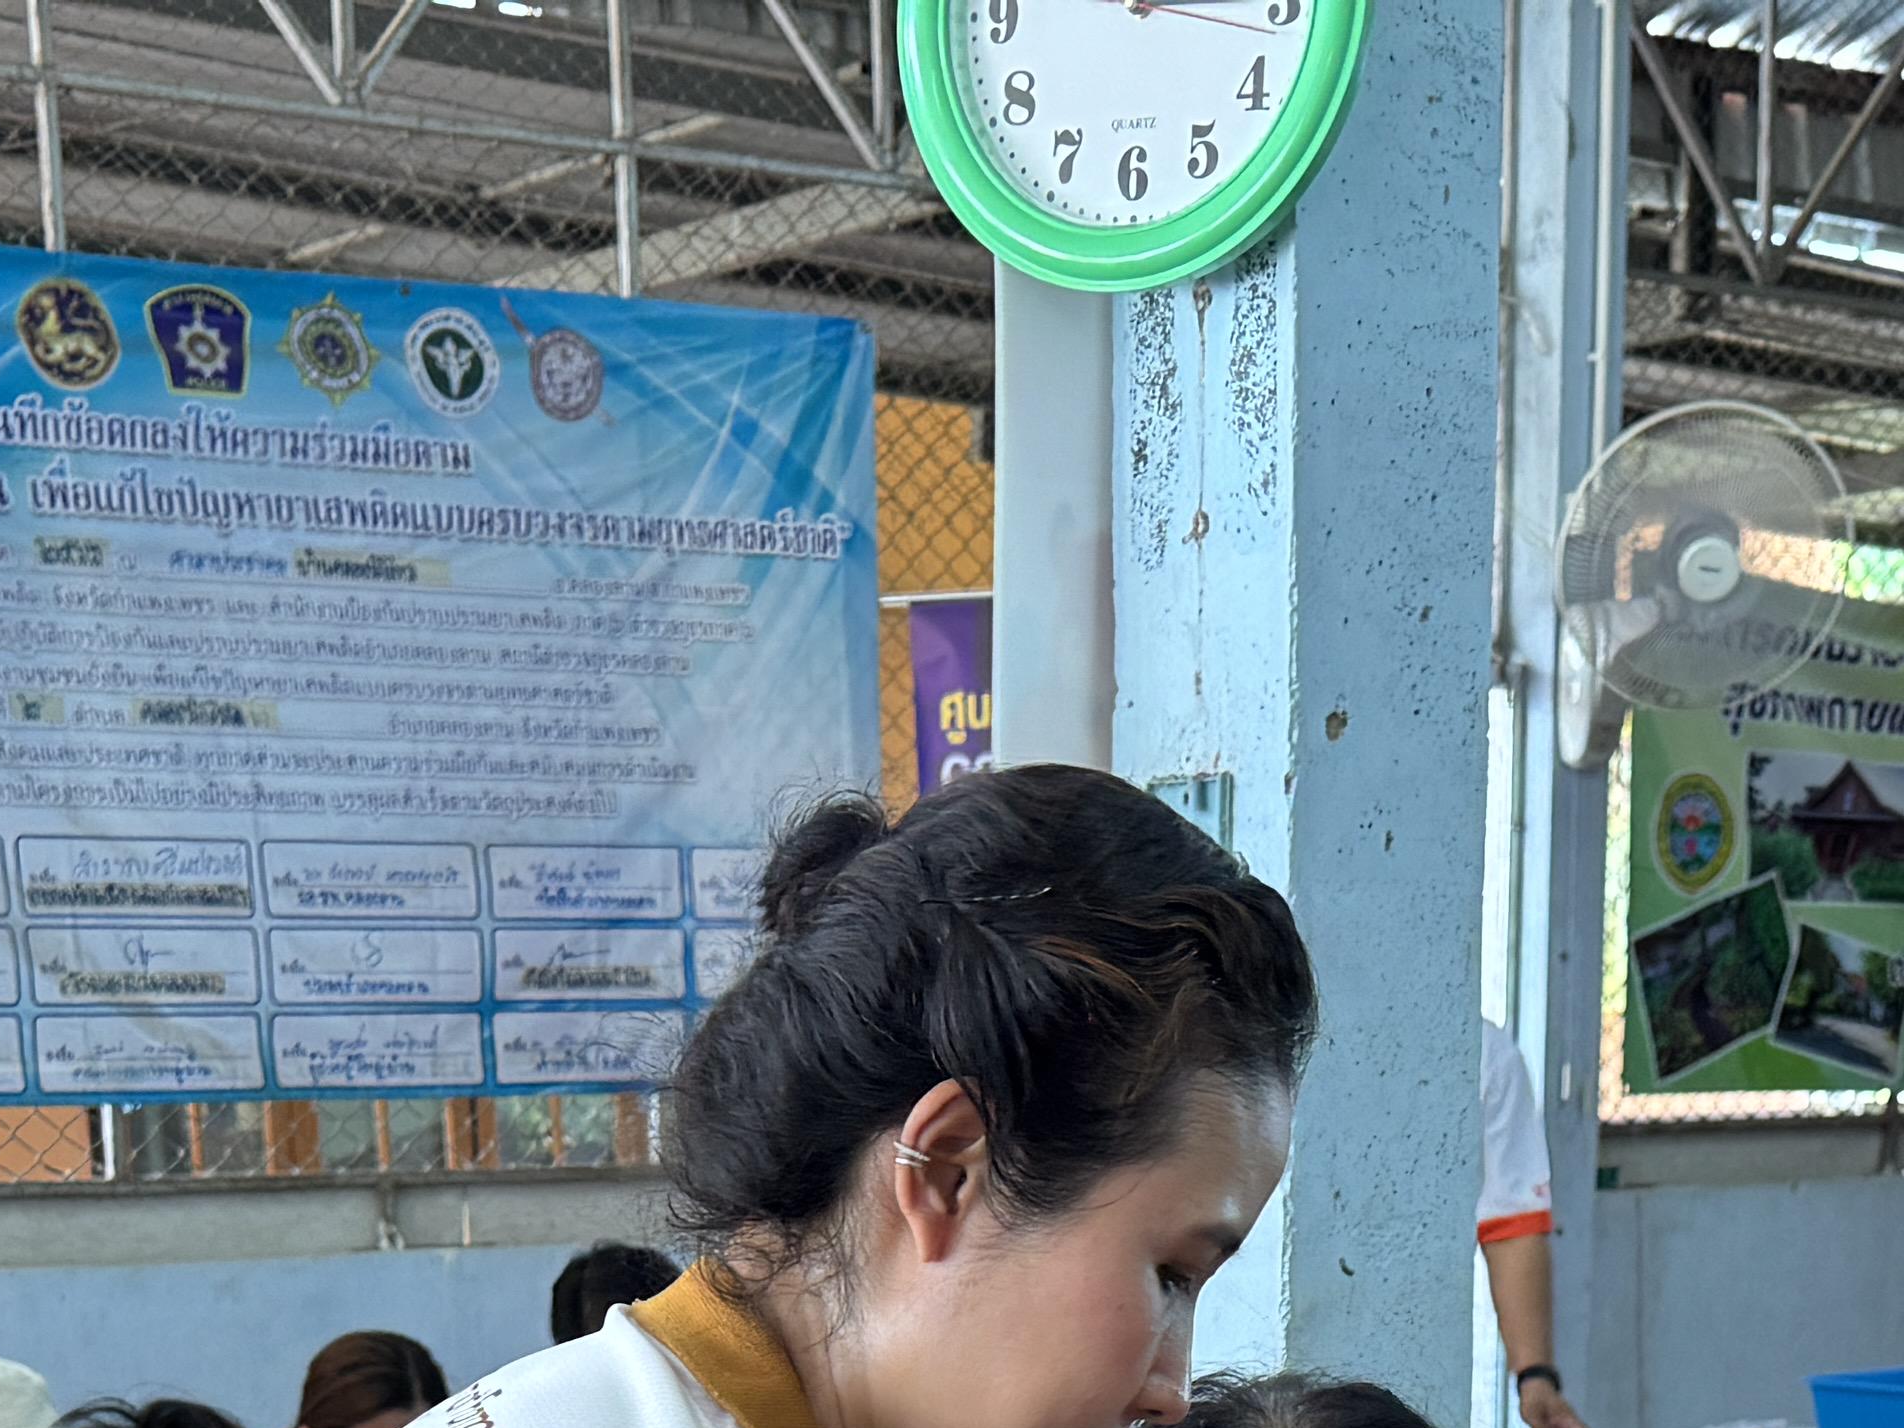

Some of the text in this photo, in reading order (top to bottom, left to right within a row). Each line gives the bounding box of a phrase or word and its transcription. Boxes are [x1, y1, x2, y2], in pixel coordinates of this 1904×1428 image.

[1003, 70, 1035, 125] 8
[1236, 55, 1270, 111] 4
[1111, 117, 1156, 133] QUARTZ
[1187, 119, 1219, 179] 5
[1053, 128, 1082, 184] 7
[1118, 145, 1148, 201] 6
